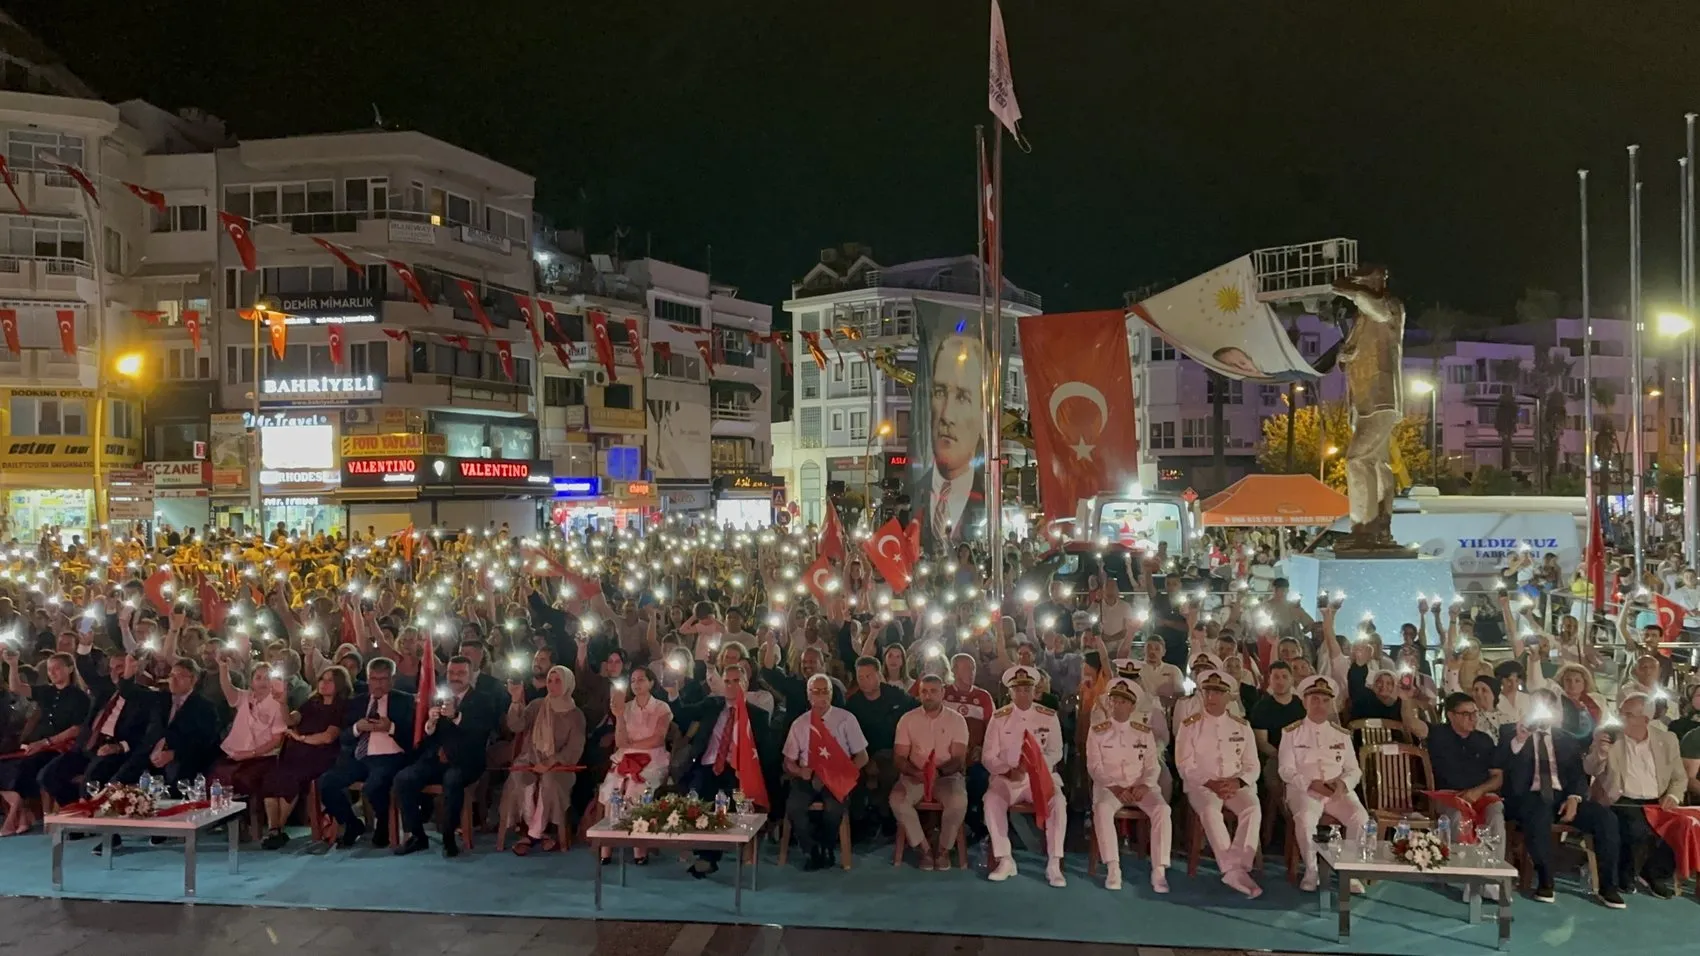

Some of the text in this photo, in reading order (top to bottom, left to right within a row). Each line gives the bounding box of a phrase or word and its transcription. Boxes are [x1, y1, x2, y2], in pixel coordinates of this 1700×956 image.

[284, 296, 373, 310] DEMİR MİMARLIK
[264, 375, 375, 393] BAHRİYELİ
[145, 463, 199, 475] ECZANE
[348, 460, 415, 473] VALENTINO
[461, 462, 528, 477] VALENTINO
[280, 472, 323, 482] RHODES
[1458, 538, 1516, 548] YILDIZ
